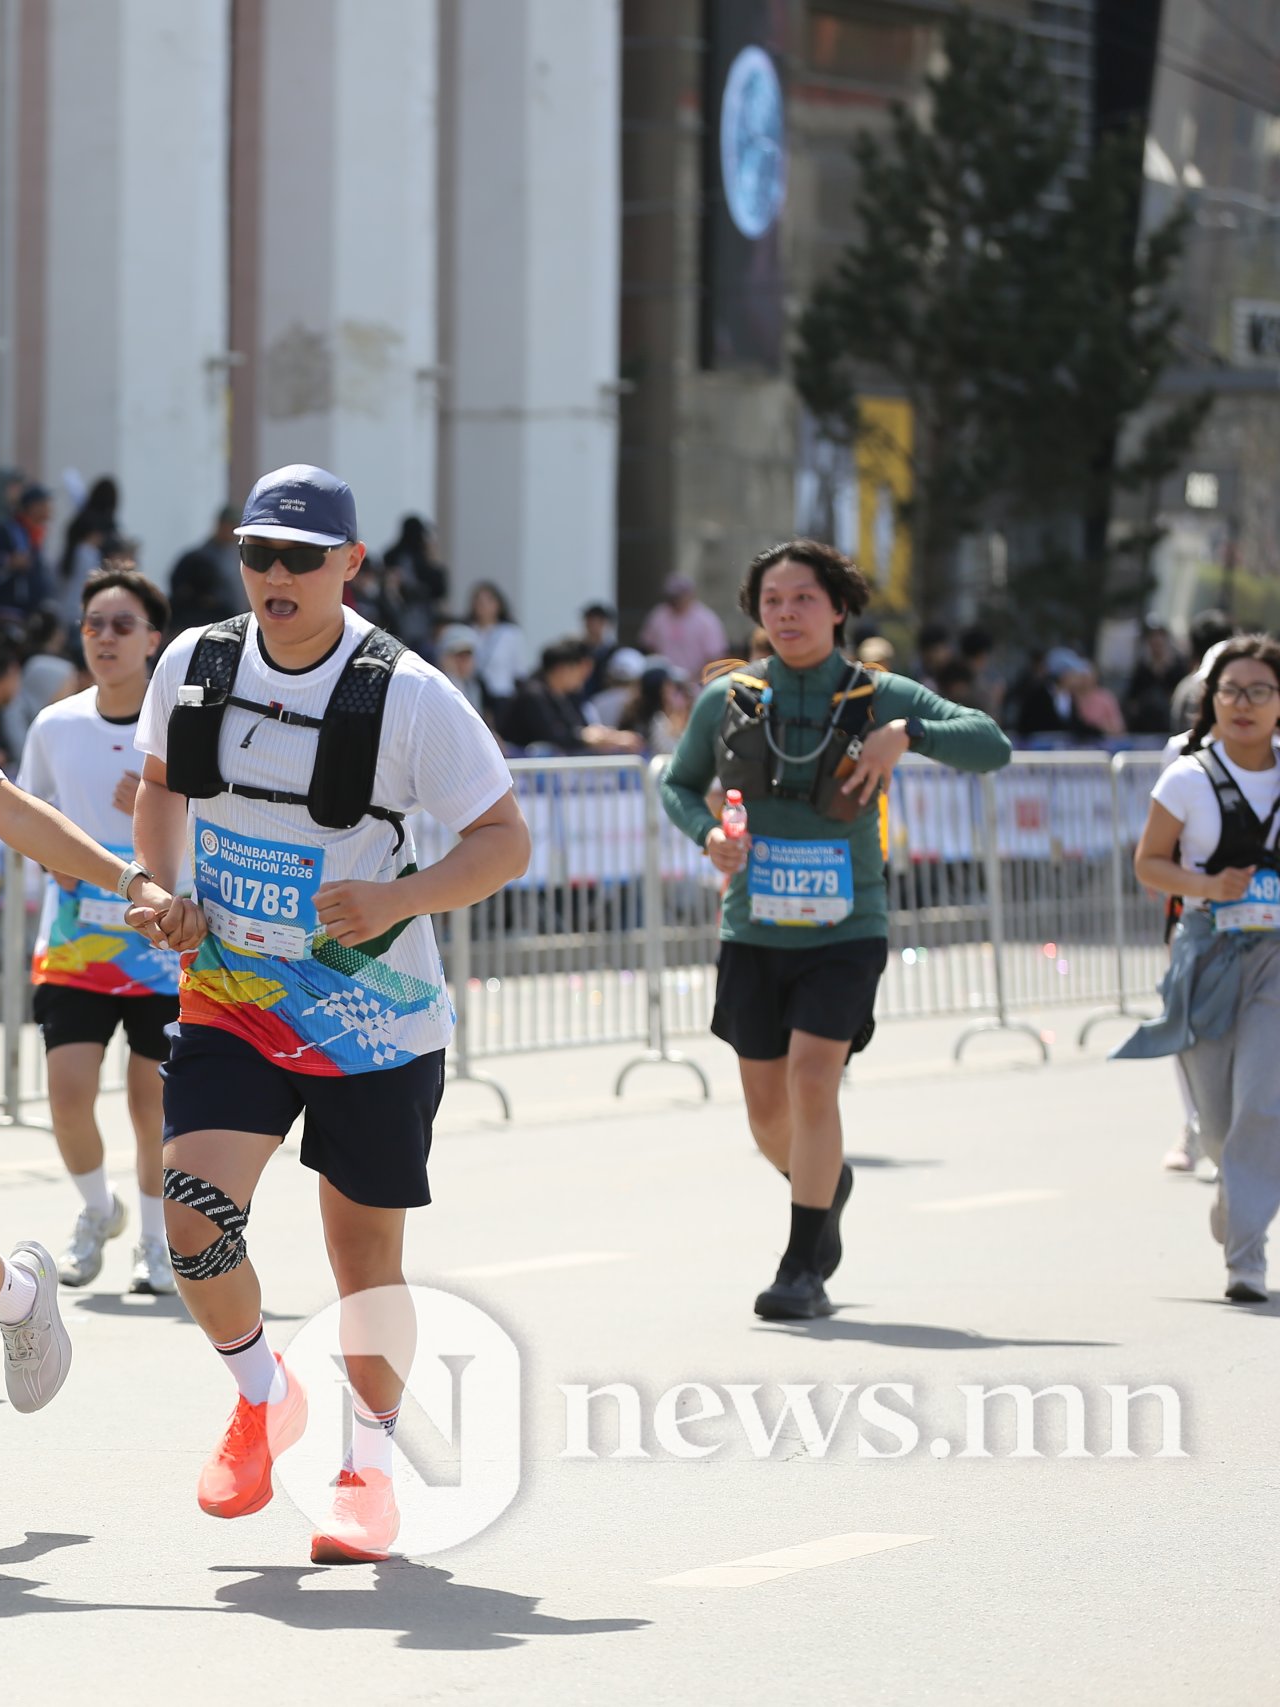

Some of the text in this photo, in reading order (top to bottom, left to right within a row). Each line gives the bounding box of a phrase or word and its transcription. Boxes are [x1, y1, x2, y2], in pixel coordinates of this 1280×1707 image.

[280, 498, 306, 506] negative
[220, 848, 313, 879] MARATHON 2026
[221, 836, 300, 865] ULAANBAATAR
[220, 870, 299, 919] 01783
[772, 868, 839, 895] 01279
